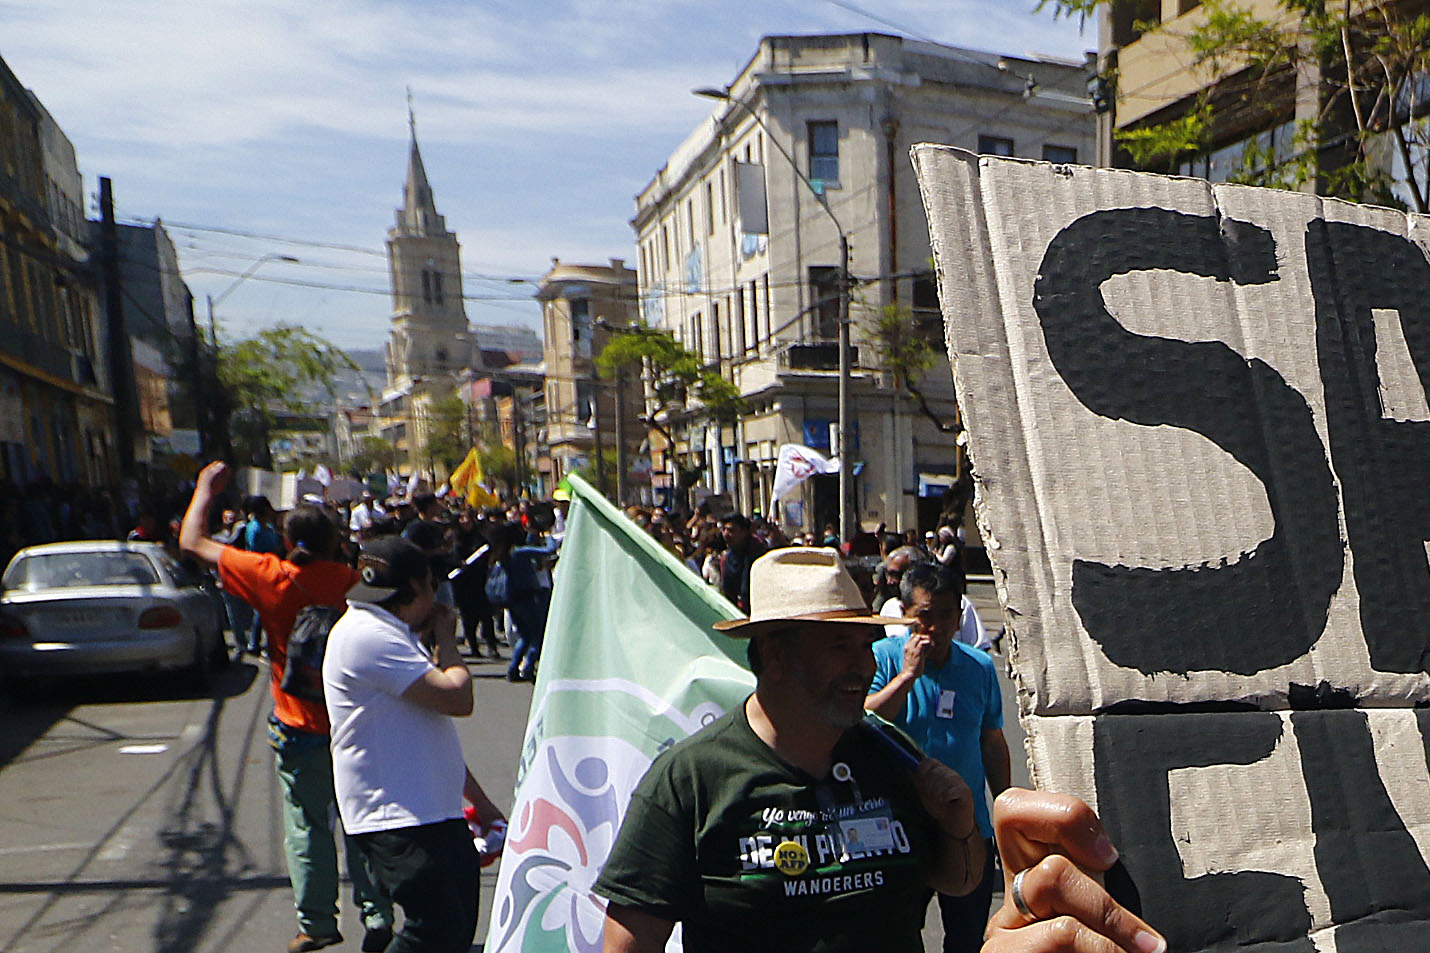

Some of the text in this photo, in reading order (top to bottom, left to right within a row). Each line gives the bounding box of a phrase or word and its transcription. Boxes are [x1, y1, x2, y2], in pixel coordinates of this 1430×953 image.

[759, 807, 784, 829] Yo
[738, 836, 775, 870] DE
[784, 871, 883, 897] WANDERERS
